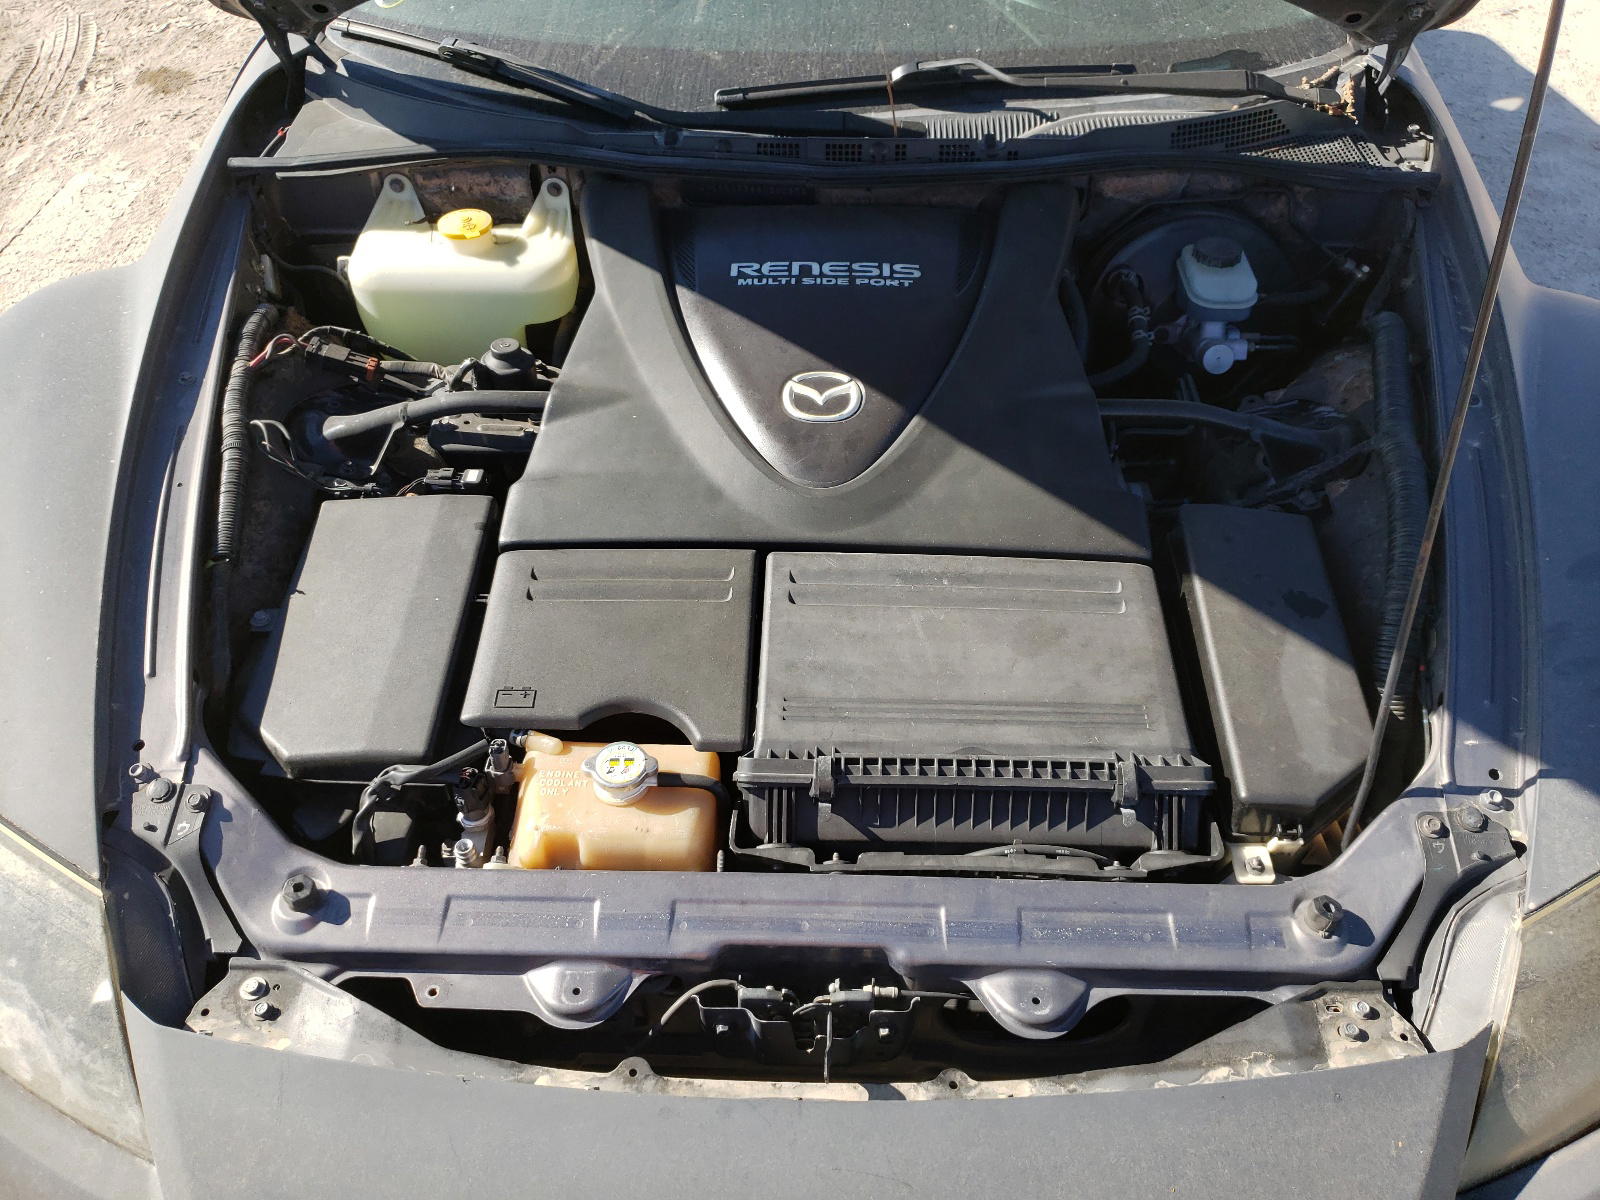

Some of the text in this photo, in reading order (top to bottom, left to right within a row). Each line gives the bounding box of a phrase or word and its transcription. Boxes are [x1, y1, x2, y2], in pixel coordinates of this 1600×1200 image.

[730, 261, 922, 279] RENESIS
[737, 277, 914, 288] MULTI SIDE PORT
[540, 779, 589, 788] COOLANT
